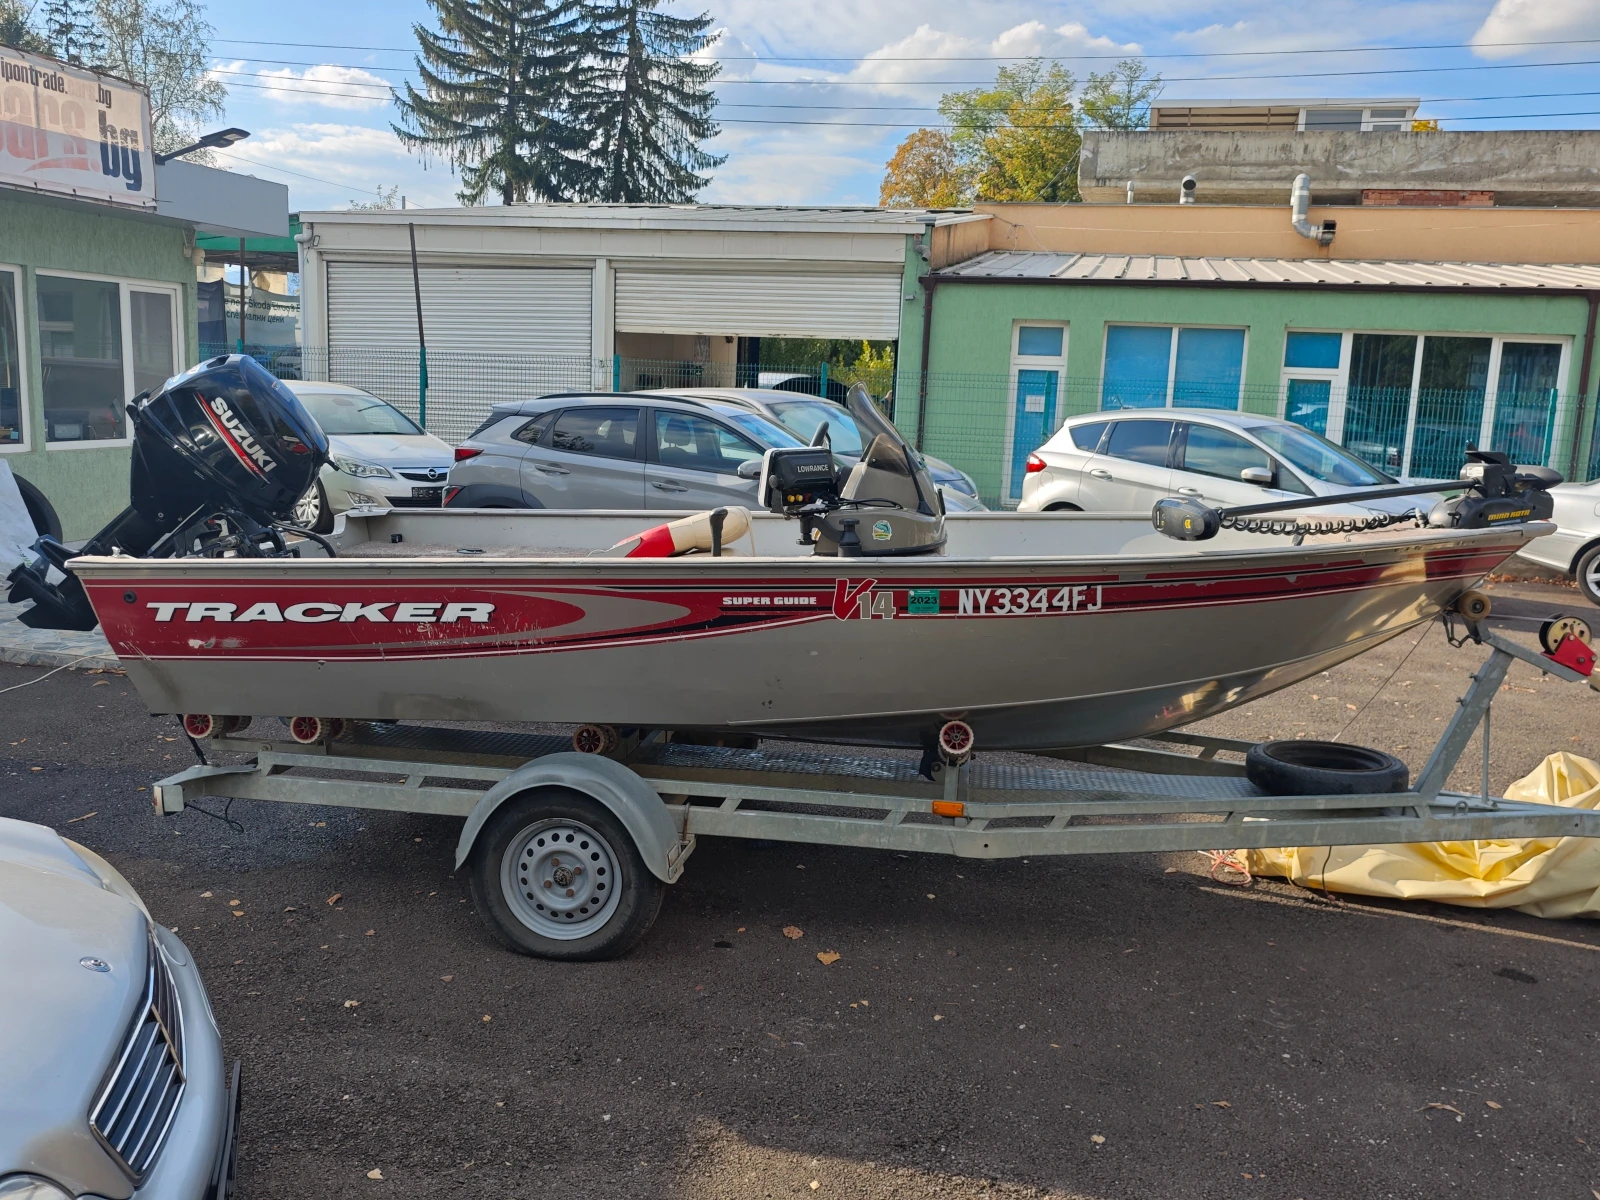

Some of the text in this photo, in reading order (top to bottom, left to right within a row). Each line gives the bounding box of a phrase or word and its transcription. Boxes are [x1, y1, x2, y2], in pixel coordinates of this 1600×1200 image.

[248, 297, 271, 310] Škoda
[226, 310, 285, 324] спеиални цени
[210, 397, 278, 473] SUZUKI
[797, 464, 829, 473] LOWRANCE
[722, 596, 771, 605] SUPER
[773, 596, 817, 605] GUIDE
[910, 596, 938, 605] 2023
[958, 585, 1103, 615] NY3344FJ
[146, 602, 497, 623] TRACKER
